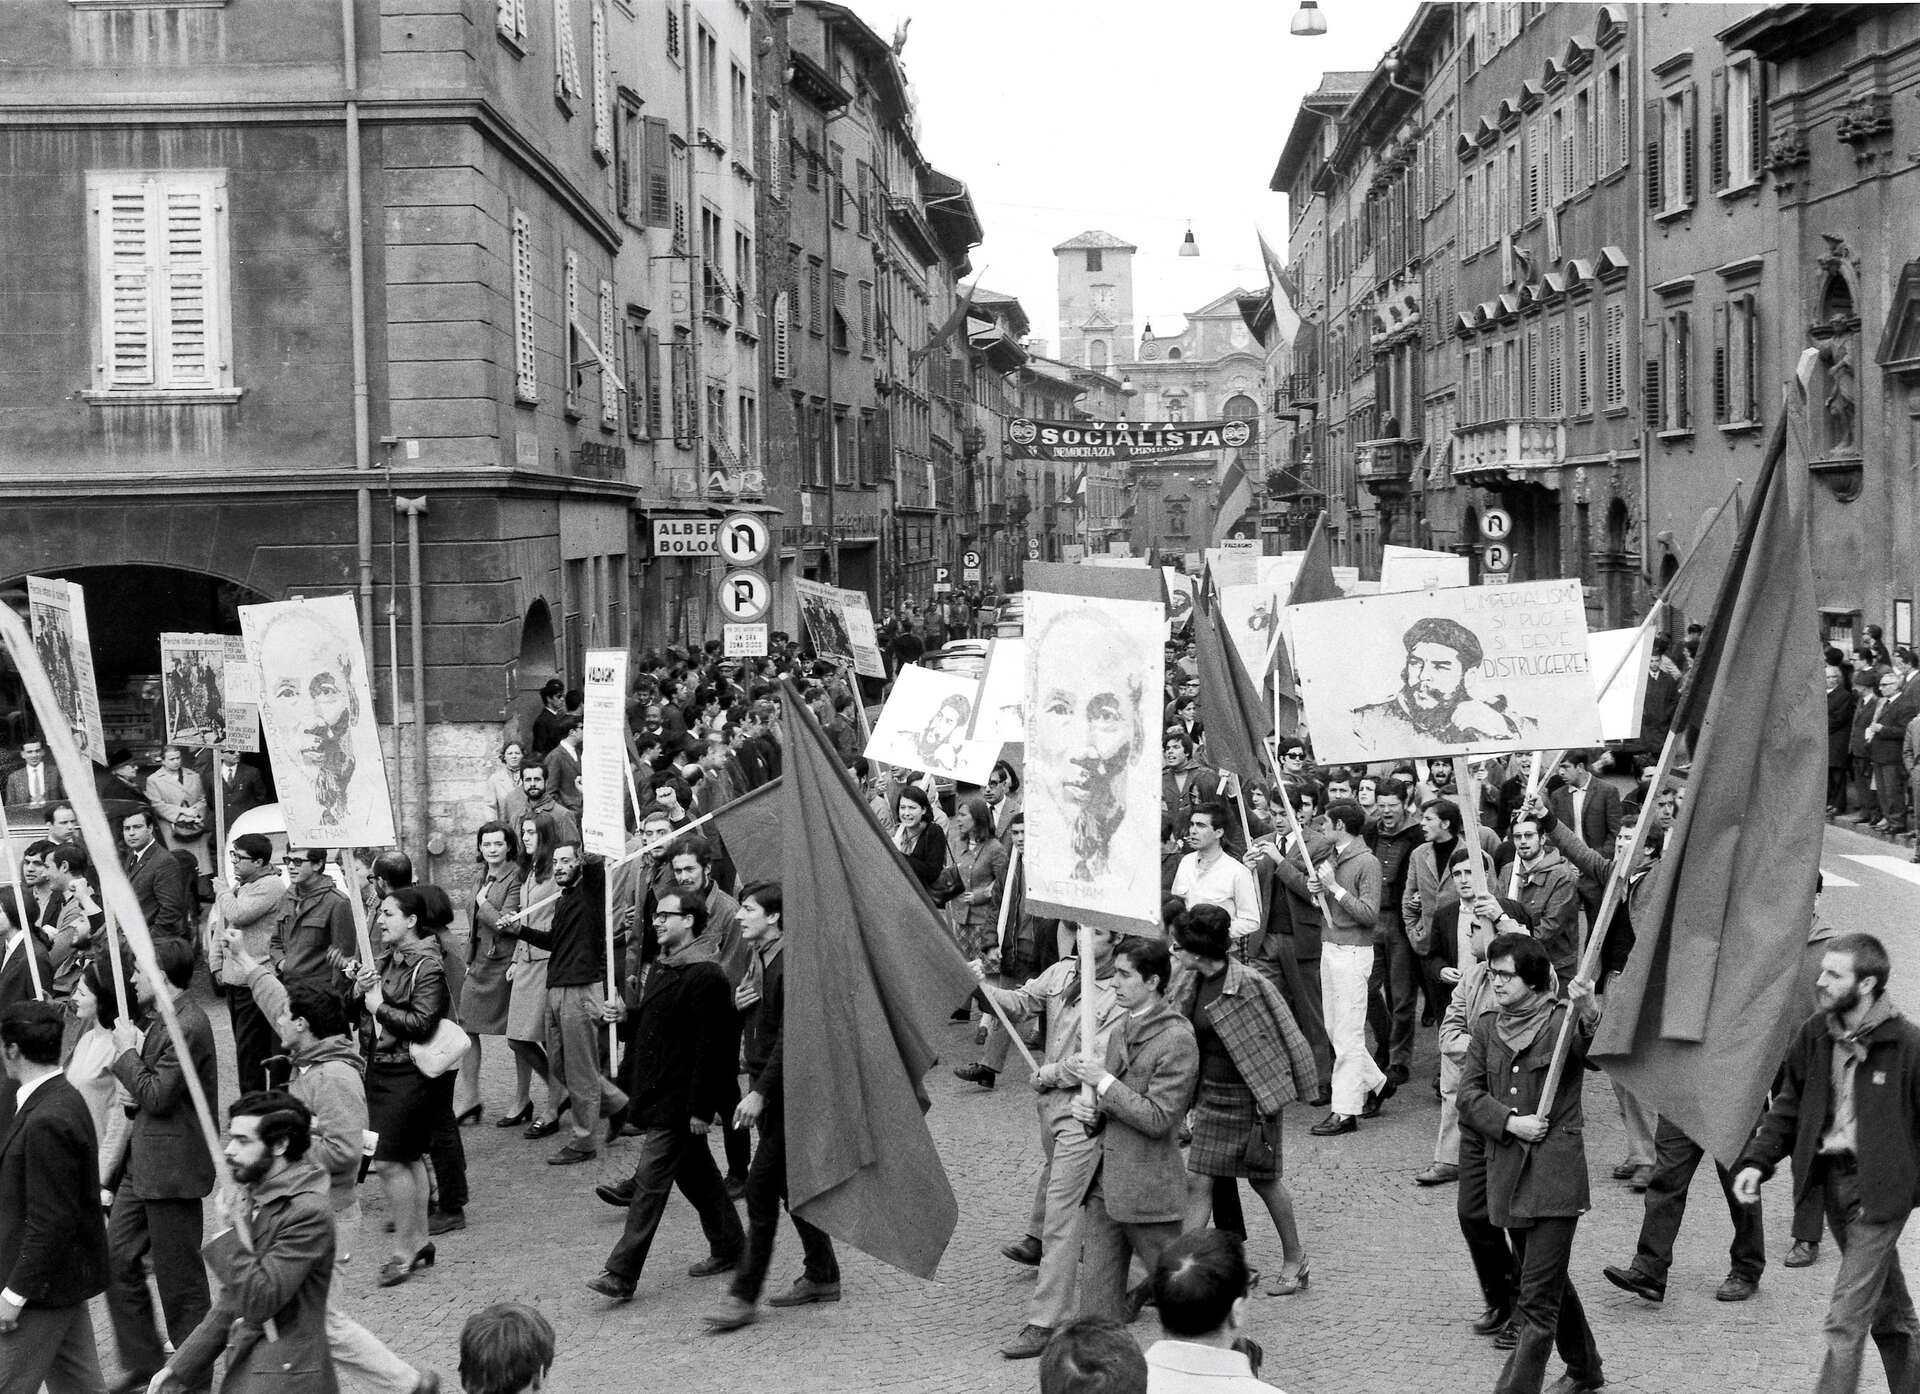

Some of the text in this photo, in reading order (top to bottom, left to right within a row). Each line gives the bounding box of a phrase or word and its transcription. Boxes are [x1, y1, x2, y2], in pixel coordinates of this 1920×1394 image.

[1093, 422, 1176, 431] VOTA
[1041, 428, 1221, 446] SOCIALISTA
[1053, 446, 1116, 458] DEMOCRAZIA
[673, 470, 766, 493] BAR
[936, 568, 949, 582] P
